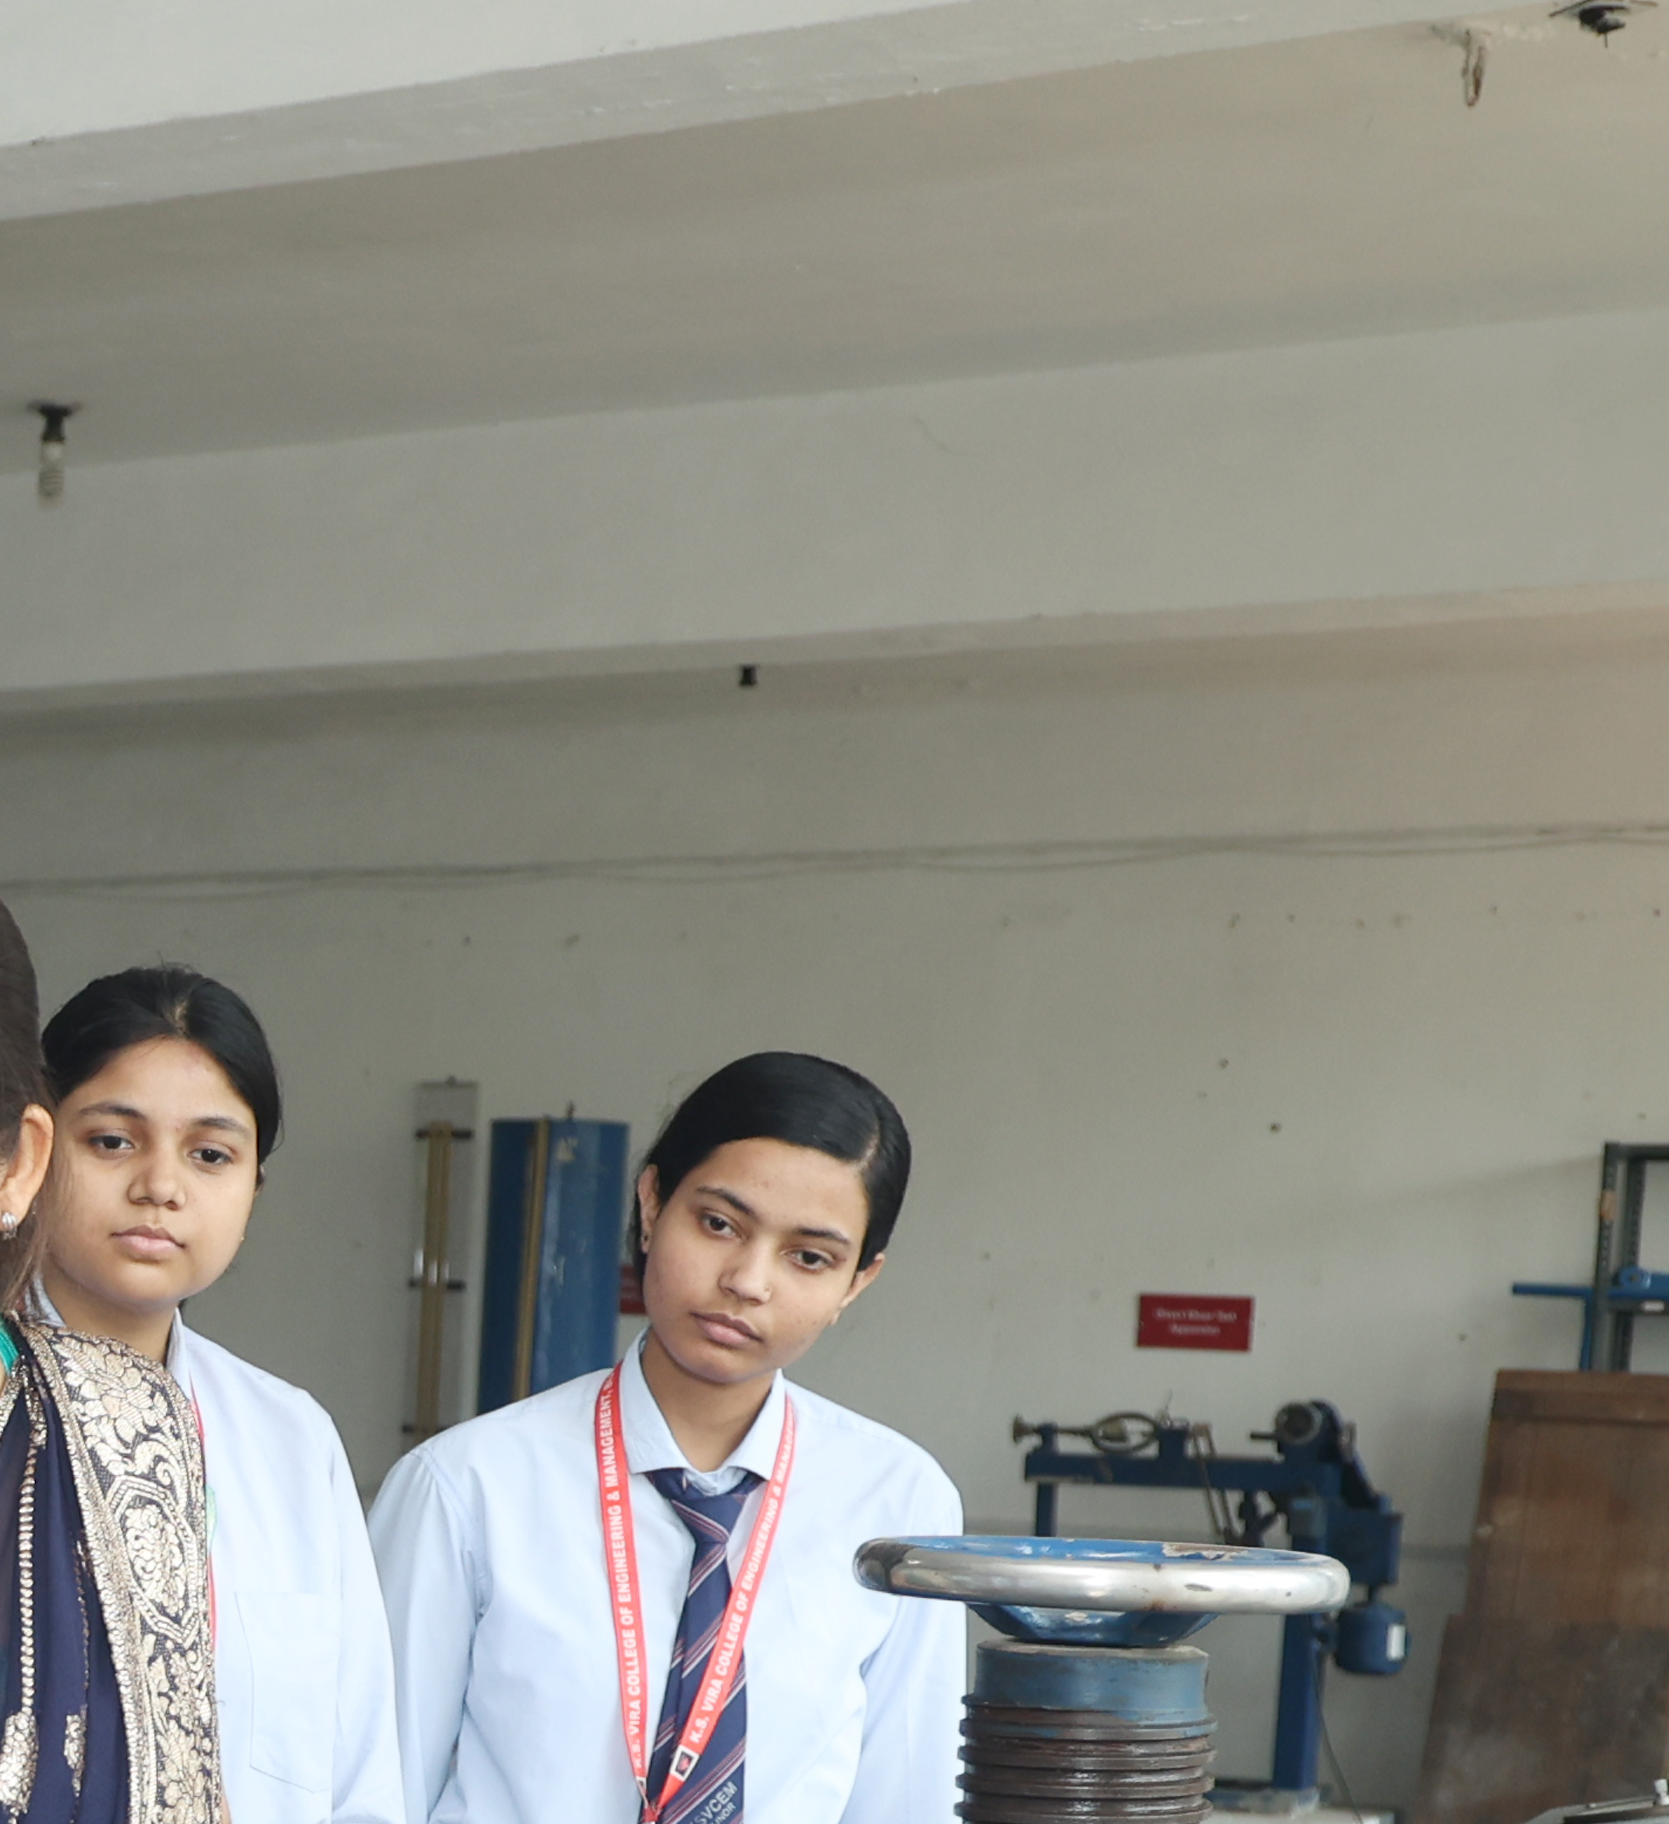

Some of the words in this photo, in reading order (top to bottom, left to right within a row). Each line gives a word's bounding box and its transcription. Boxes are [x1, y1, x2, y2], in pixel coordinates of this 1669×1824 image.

[606, 1490, 621, 1501] &
[607, 1500, 632, 1603] ENGINEERING
[742, 1496, 779, 1592] ENGINEERING
[619, 1607, 634, 1626] OF
[736, 1592, 750, 1612] OF
[623, 1628, 641, 1696] COLLEGE
[715, 1612, 743, 1676] COLLEGE
[702, 1679, 724, 1712] VIRA
[628, 1698, 641, 1735] VIRA
